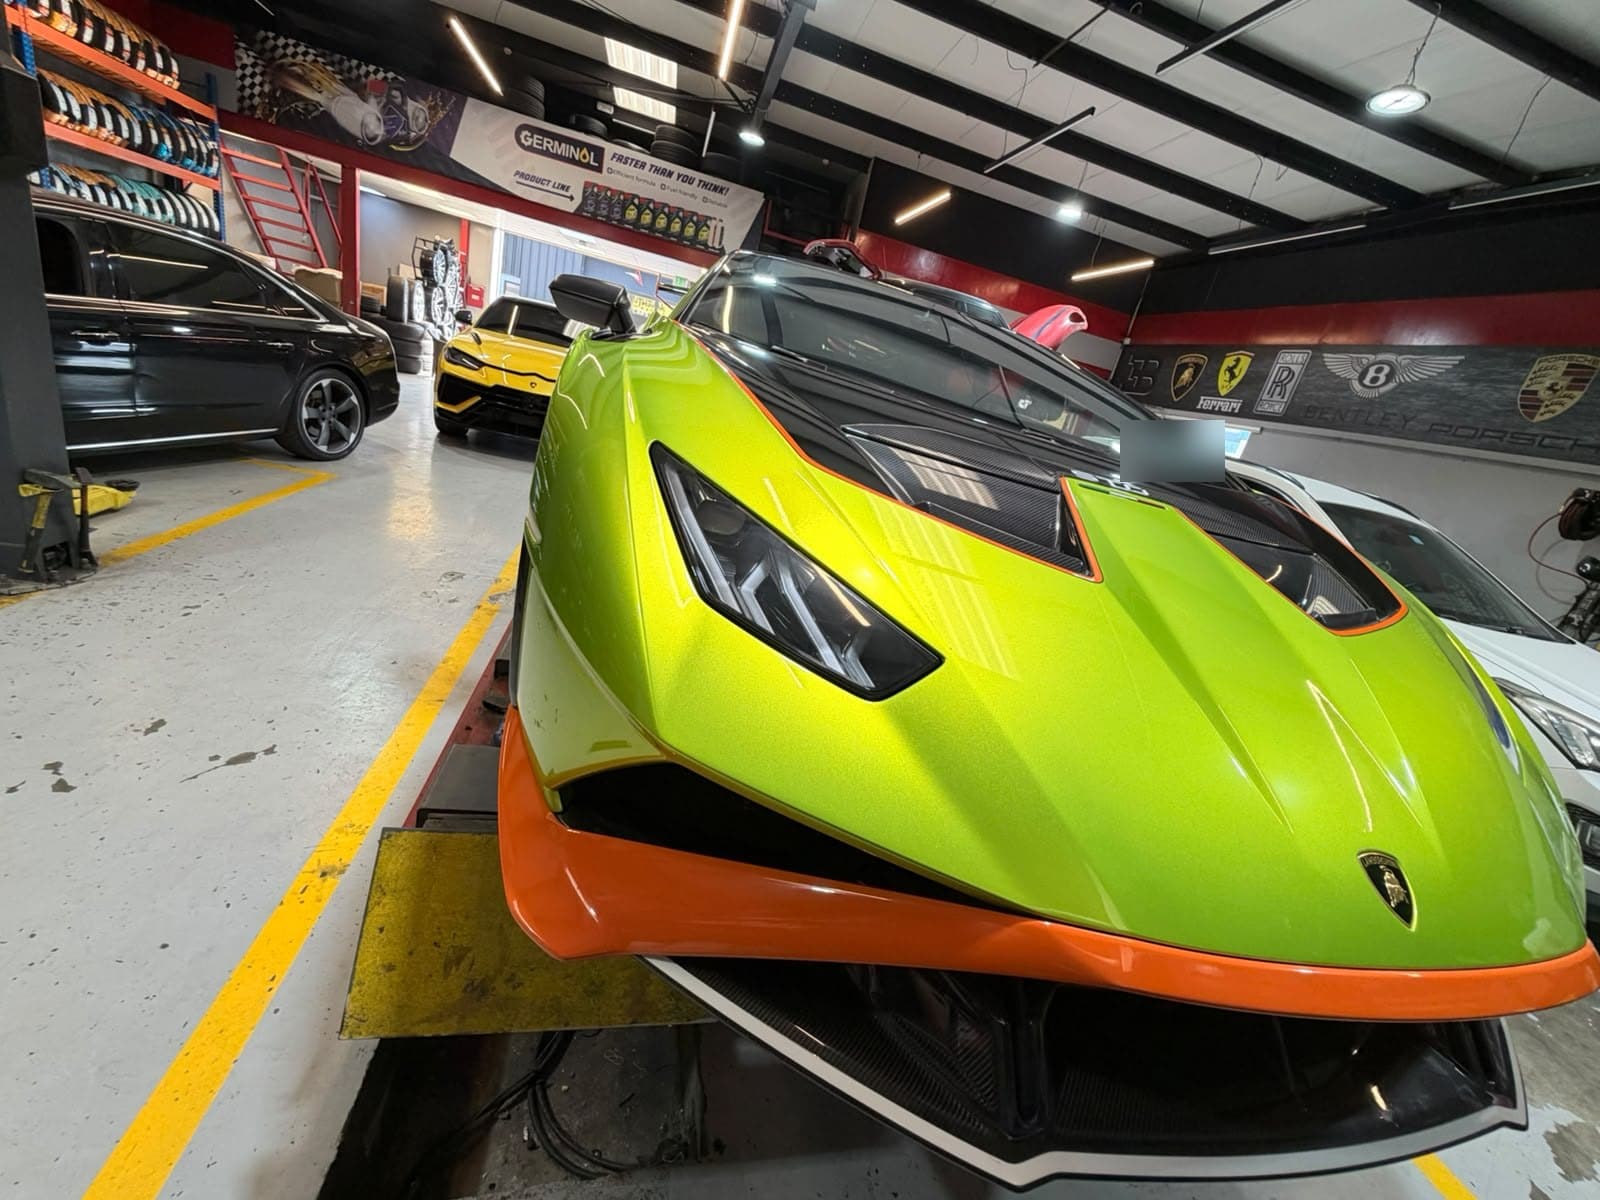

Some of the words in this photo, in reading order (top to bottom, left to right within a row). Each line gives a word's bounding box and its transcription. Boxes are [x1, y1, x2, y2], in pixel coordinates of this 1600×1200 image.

[520, 130, 599, 166] GERMINOL
[513, 170, 551, 187] PRODUCT
[552, 181, 571, 193] LINE
[610, 152, 647, 170] FASTER
[648, 163, 675, 179] THAN
[676, 172, 697, 186] YOU
[697, 178, 730, 196] THINK!
[1196, 396, 1243, 414] Ferrari
[1303, 404, 1417, 431] BENTLEY
